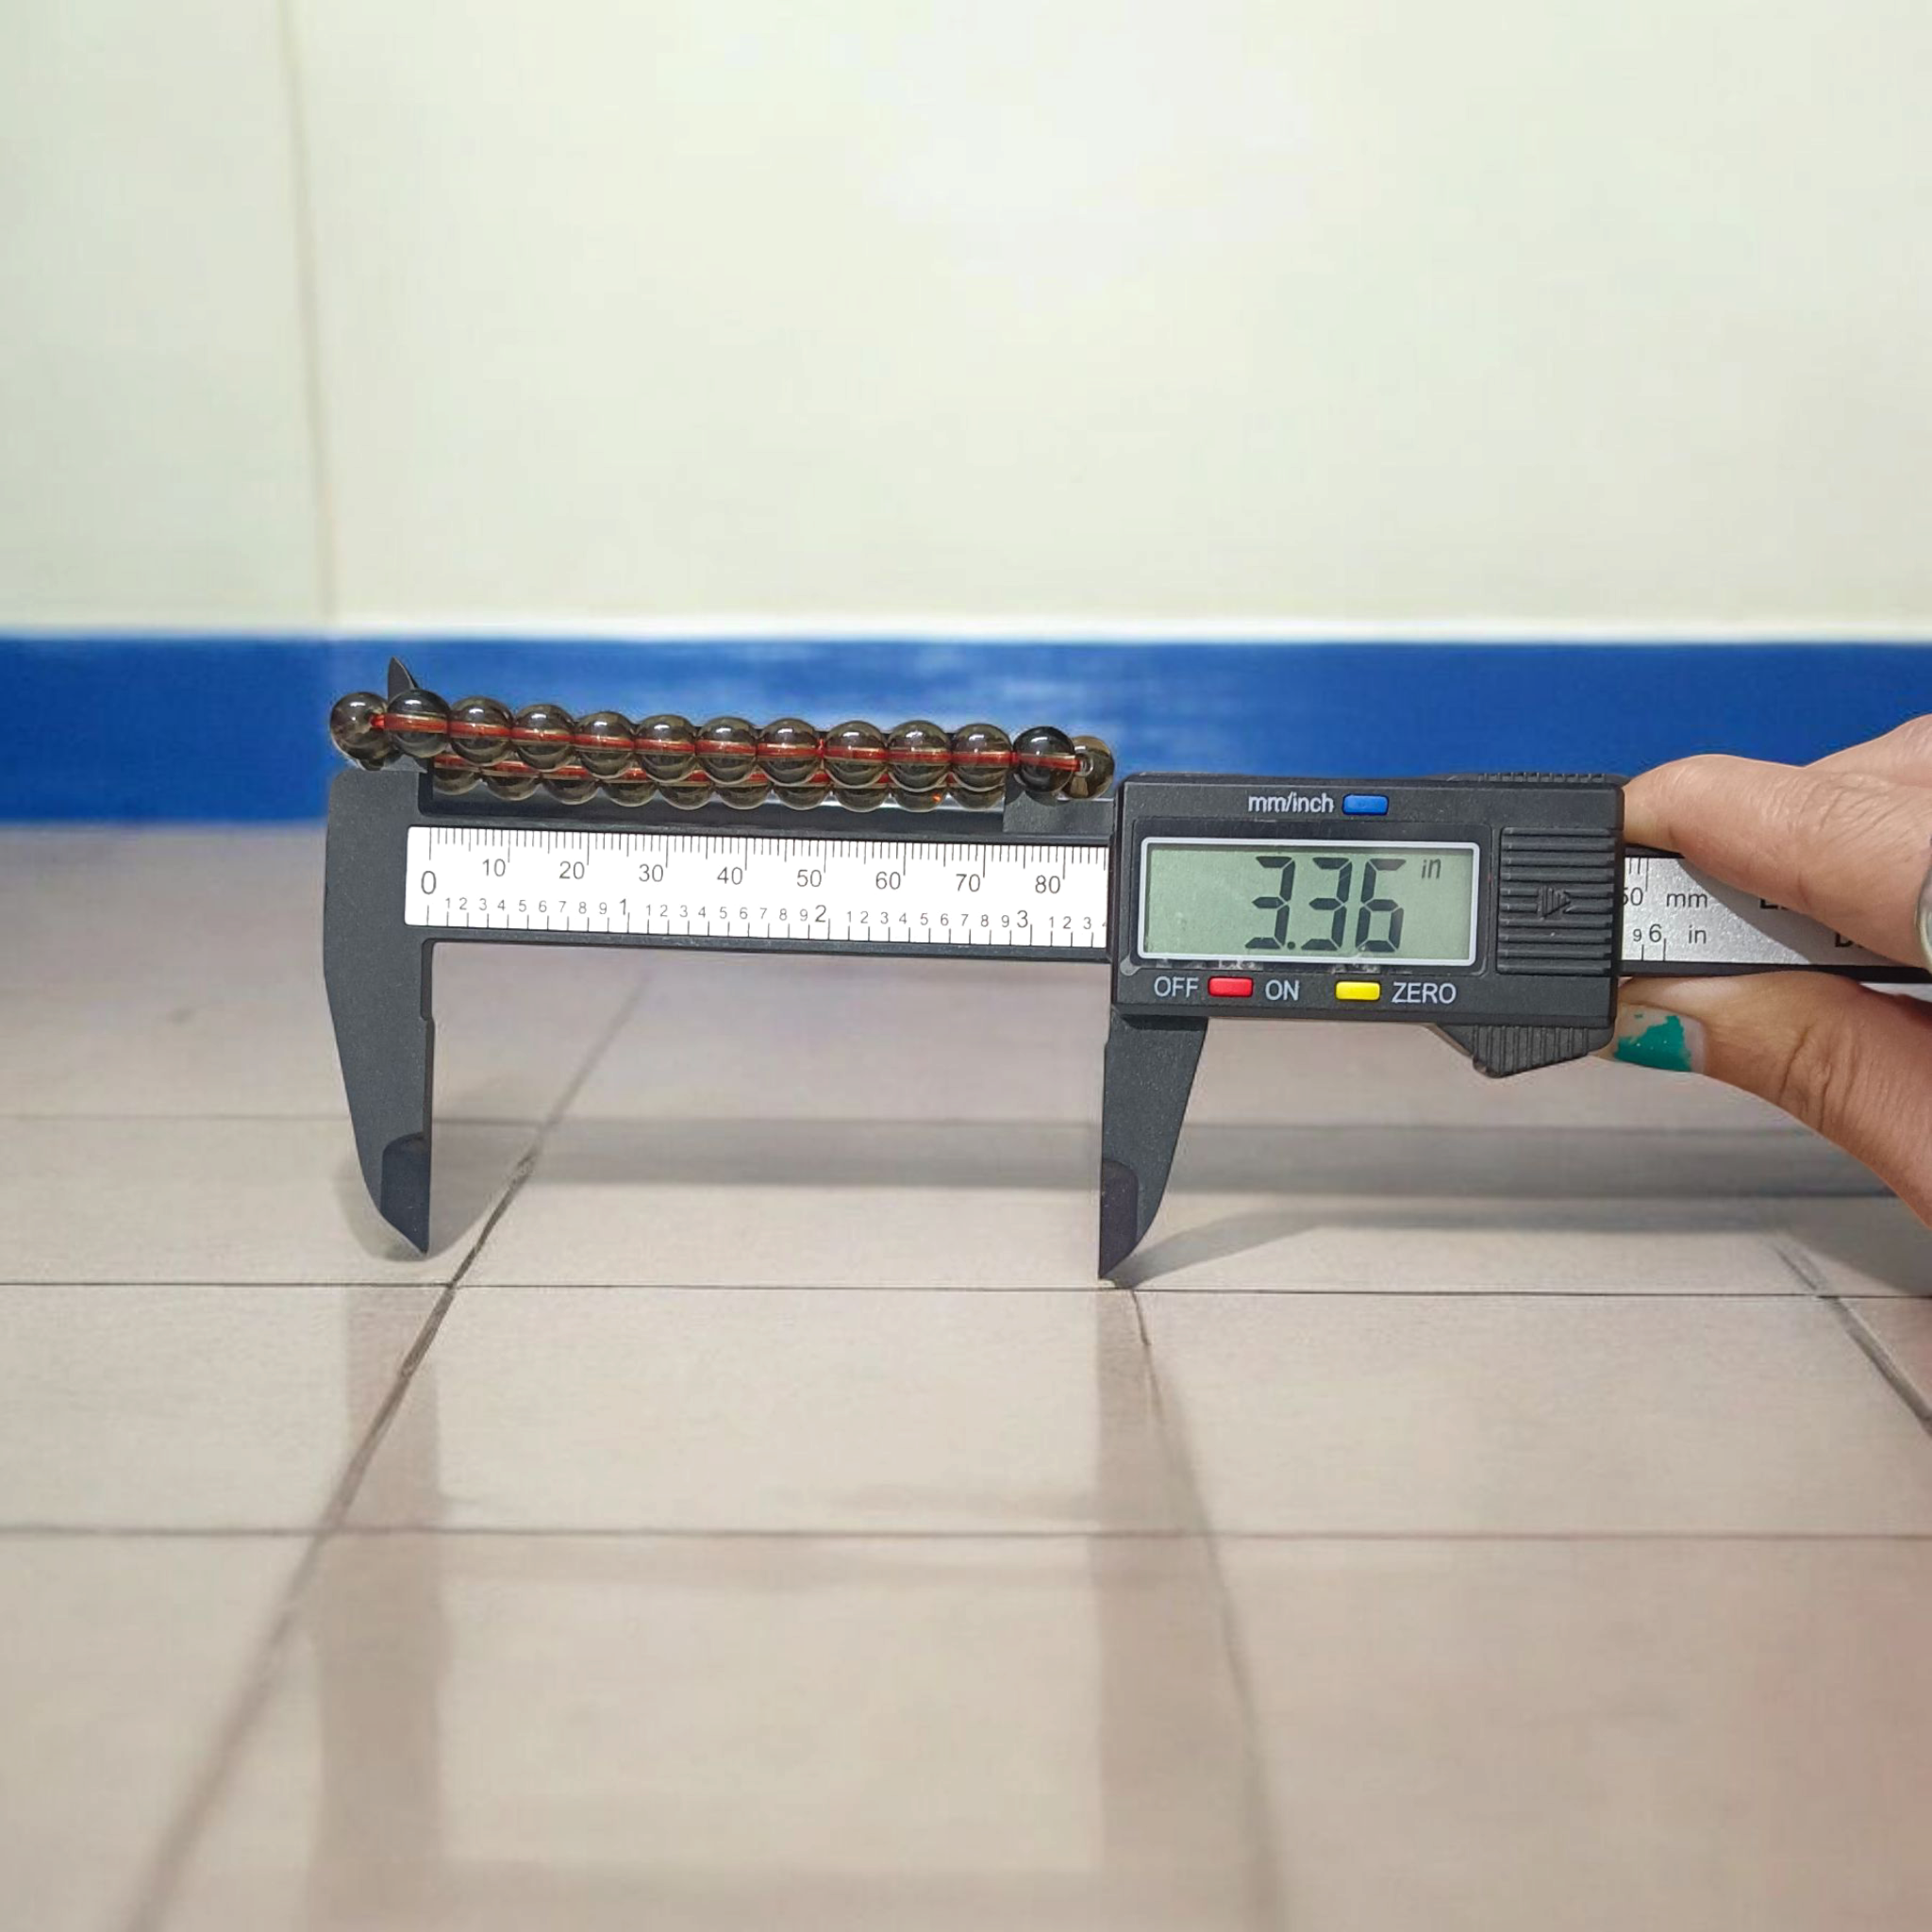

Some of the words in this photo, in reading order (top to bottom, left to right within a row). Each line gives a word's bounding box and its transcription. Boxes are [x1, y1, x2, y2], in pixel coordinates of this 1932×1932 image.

[1247, 791, 1335, 813] mm/inch
[420, 870, 437, 895] 0
[482, 858, 507, 877] 10
[558, 860, 585, 880] 20
[639, 863, 664, 883] 30
[716, 866, 743, 886] 40
[796, 869, 823, 888] 50
[875, 871, 902, 891] 60
[956, 873, 981, 892] 70
[1035, 874, 1061, 894] 80
[458, 896, 468, 910] 2
[478, 897, 488, 911] 3
[497, 898, 507, 911] 4
[518, 899, 527, 912] 5
[538, 900, 547, 913] 6
[558, 900, 568, 913] 7
[578, 901, 587, 914] 8
[598, 902, 608, 915] 9
[658, 904, 668, 918] 2
[679, 905, 689, 918] 3
[697, 906, 707, 918] 4
[719, 906, 727, 920] 5
[739, 907, 748, 920] 6
[758, 908, 768, 920] 7
[778, 908, 788, 922] 8
[799, 908, 808, 922] 9
[814, 904, 827, 924] 2
[859, 910, 869, 924] 2
[880, 911, 889, 924] 3
[898, 912, 908, 924] 4
[920, 912, 929, 926] 5
[940, 912, 949, 926] 6
[959, 913, 969, 926] 7
[980, 913, 990, 928] 8
[1001, 914, 1010, 928] 9
[1016, 909, 1029, 928] 3
[1062, 915, 1072, 930] 2
[1082, 916, 1092, 930] 3
[1244, 856, 1406, 953] 3.36
[1422, 858, 1443, 877] in
[1666, 892, 1708, 908] mm
[1633, 928, 1641, 941] 9
[1649, 924, 1662, 942] 6
[1688, 924, 1707, 943] in
[1154, 975, 1199, 997] OFF
[1265, 979, 1300, 1001] ON
[1391, 982, 1457, 1004] ZERO
